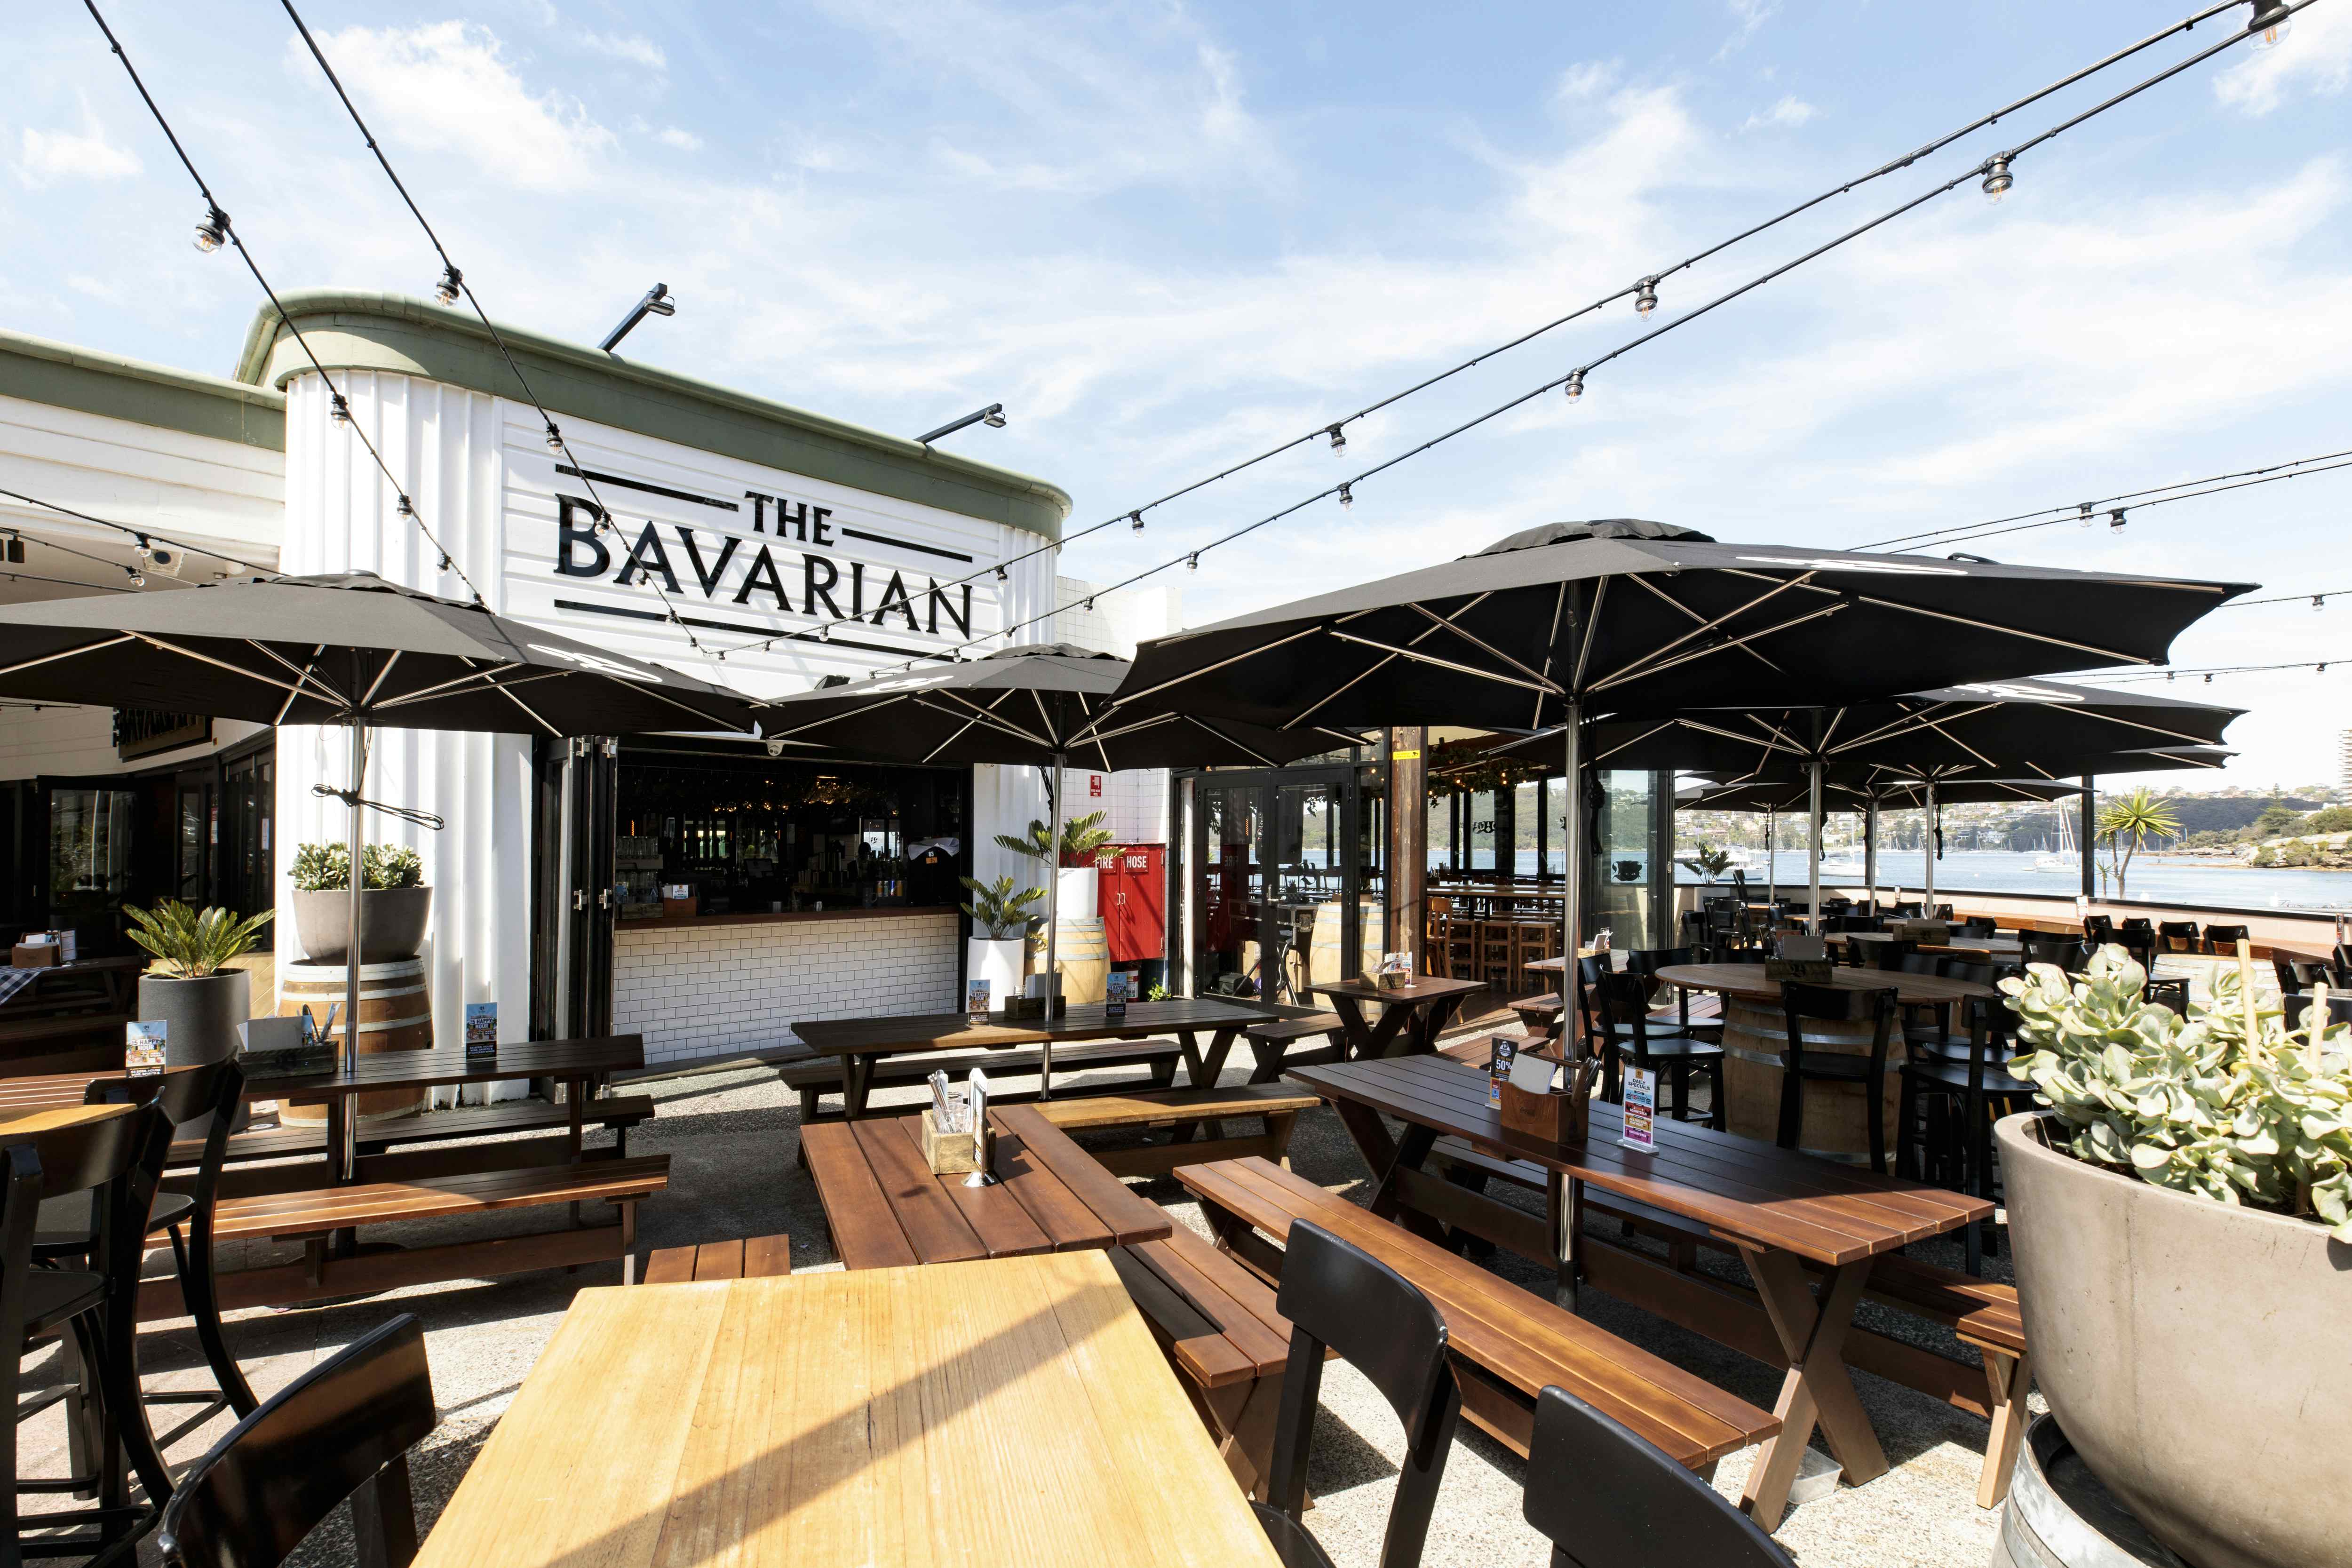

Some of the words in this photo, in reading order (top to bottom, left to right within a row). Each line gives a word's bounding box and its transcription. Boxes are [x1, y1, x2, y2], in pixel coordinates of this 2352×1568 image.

[745, 490, 835, 547] THE
[553, 493, 973, 640] BAVARIAN
[1095, 856, 1113, 869] FIRE
[1126, 856, 1147, 868] HOSE
[1496, 1059, 1512, 1070] 50%
[1628, 1082, 1650, 1090] SPECIALS
